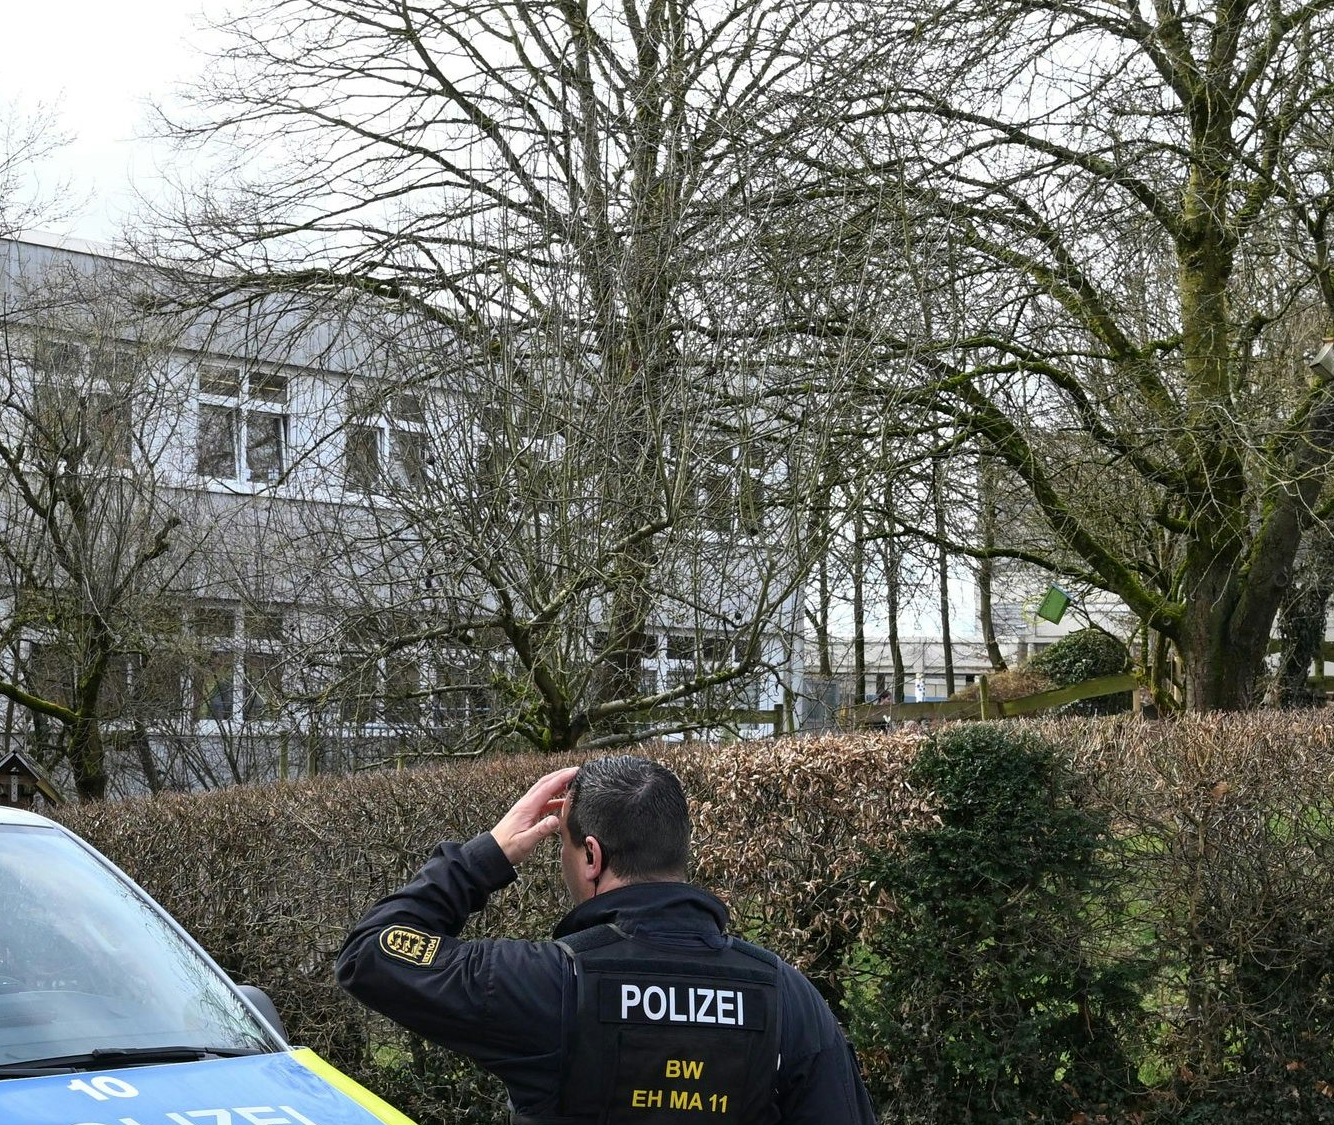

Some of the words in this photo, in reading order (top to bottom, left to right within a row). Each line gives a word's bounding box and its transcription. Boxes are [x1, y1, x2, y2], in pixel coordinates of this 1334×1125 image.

[621, 984, 744, 1026] POLIZEI
[665, 1059, 704, 1080] BW
[67, 1075, 139, 1101] 10
[631, 1089, 663, 1108] EH
[669, 1090, 703, 1111] MA
[709, 1094, 728, 1113] 11
